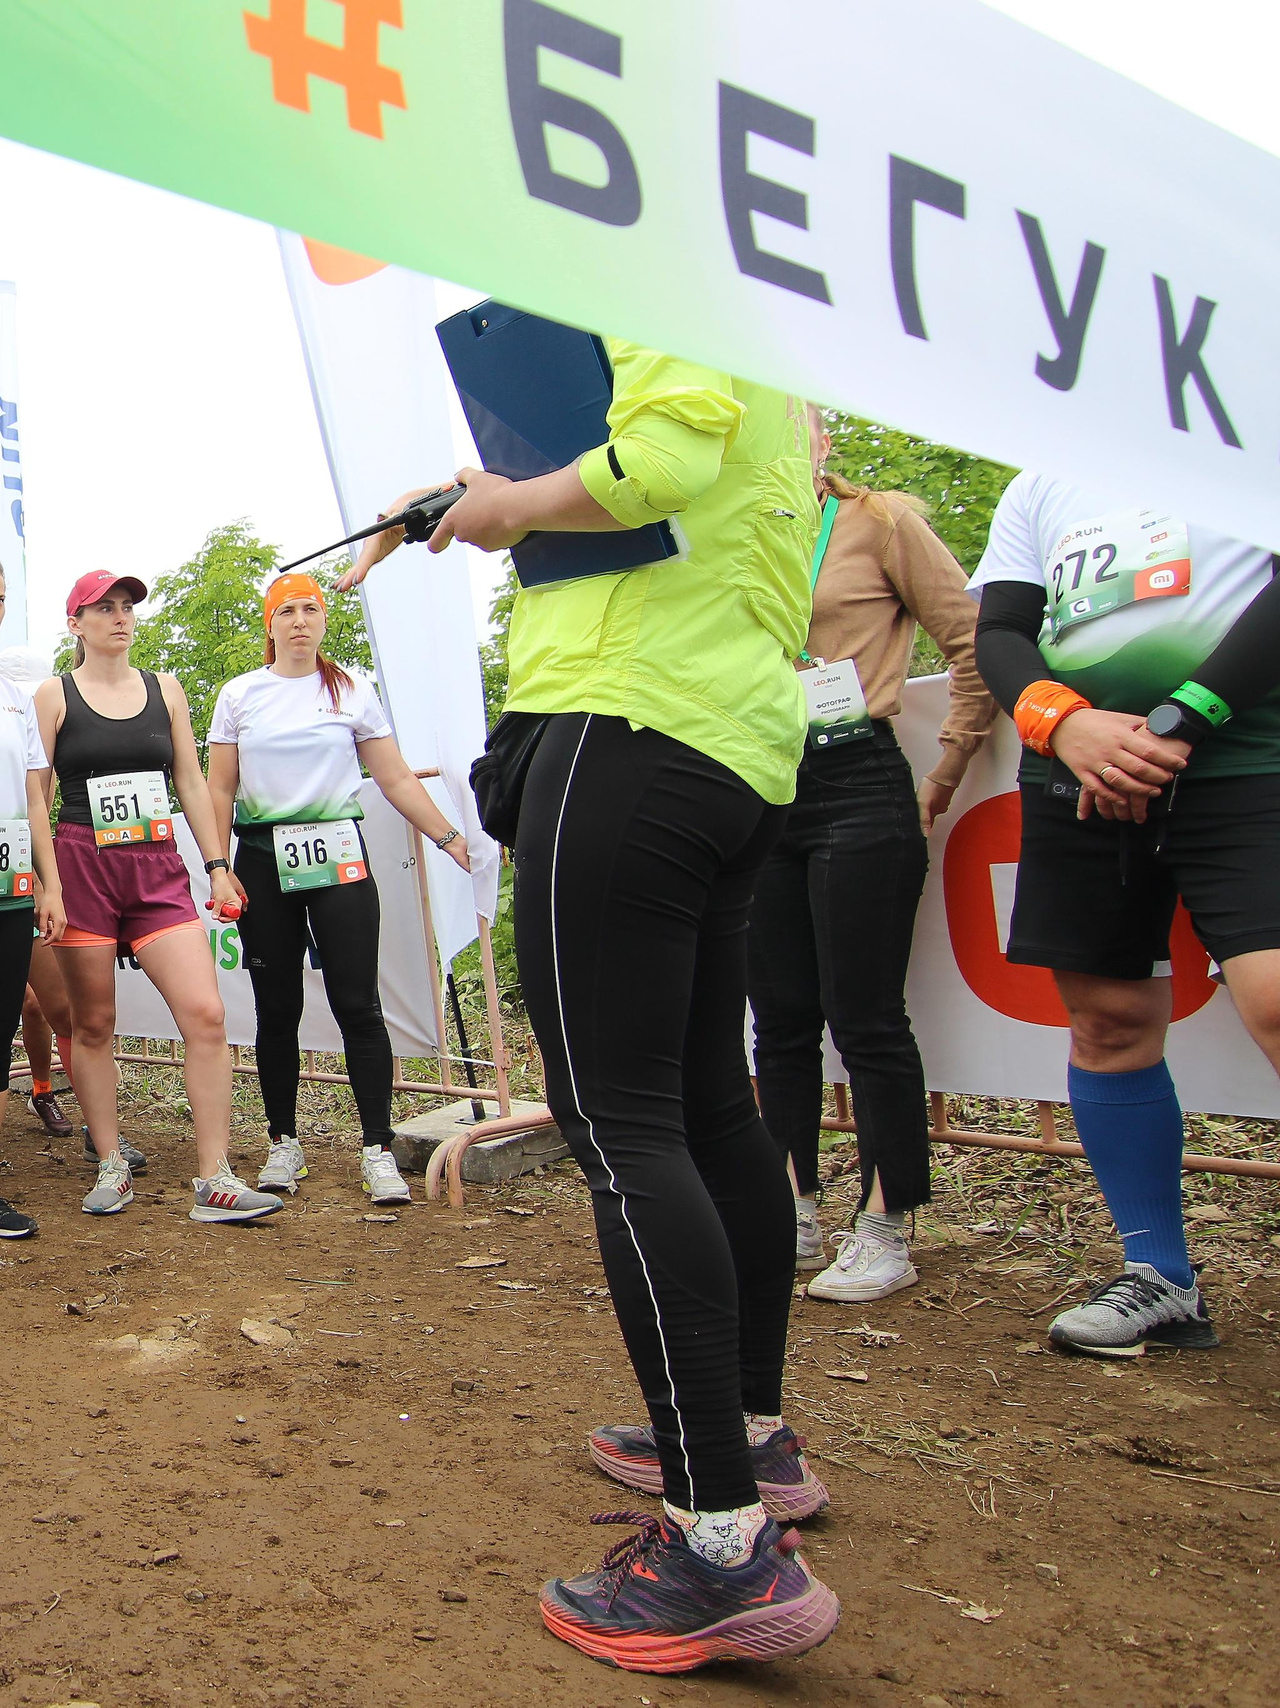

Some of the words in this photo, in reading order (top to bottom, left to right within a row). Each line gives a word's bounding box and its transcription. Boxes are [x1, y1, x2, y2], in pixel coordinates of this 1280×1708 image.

[1052, 543, 1119, 605] 272
[813, 675, 841, 687] LEO.RUN
[816, 697, 851, 709] ФОТОГРАФ
[104, 779, 132, 788] LEO.RUN
[99, 793, 141, 823] 551
[289, 825, 318, 834] LEO.RUN
[102, 832, 115, 841] 10
[122, 831, 130, 840] A
[284, 838, 328, 869] 316
[288, 878, 295, 887] 5
